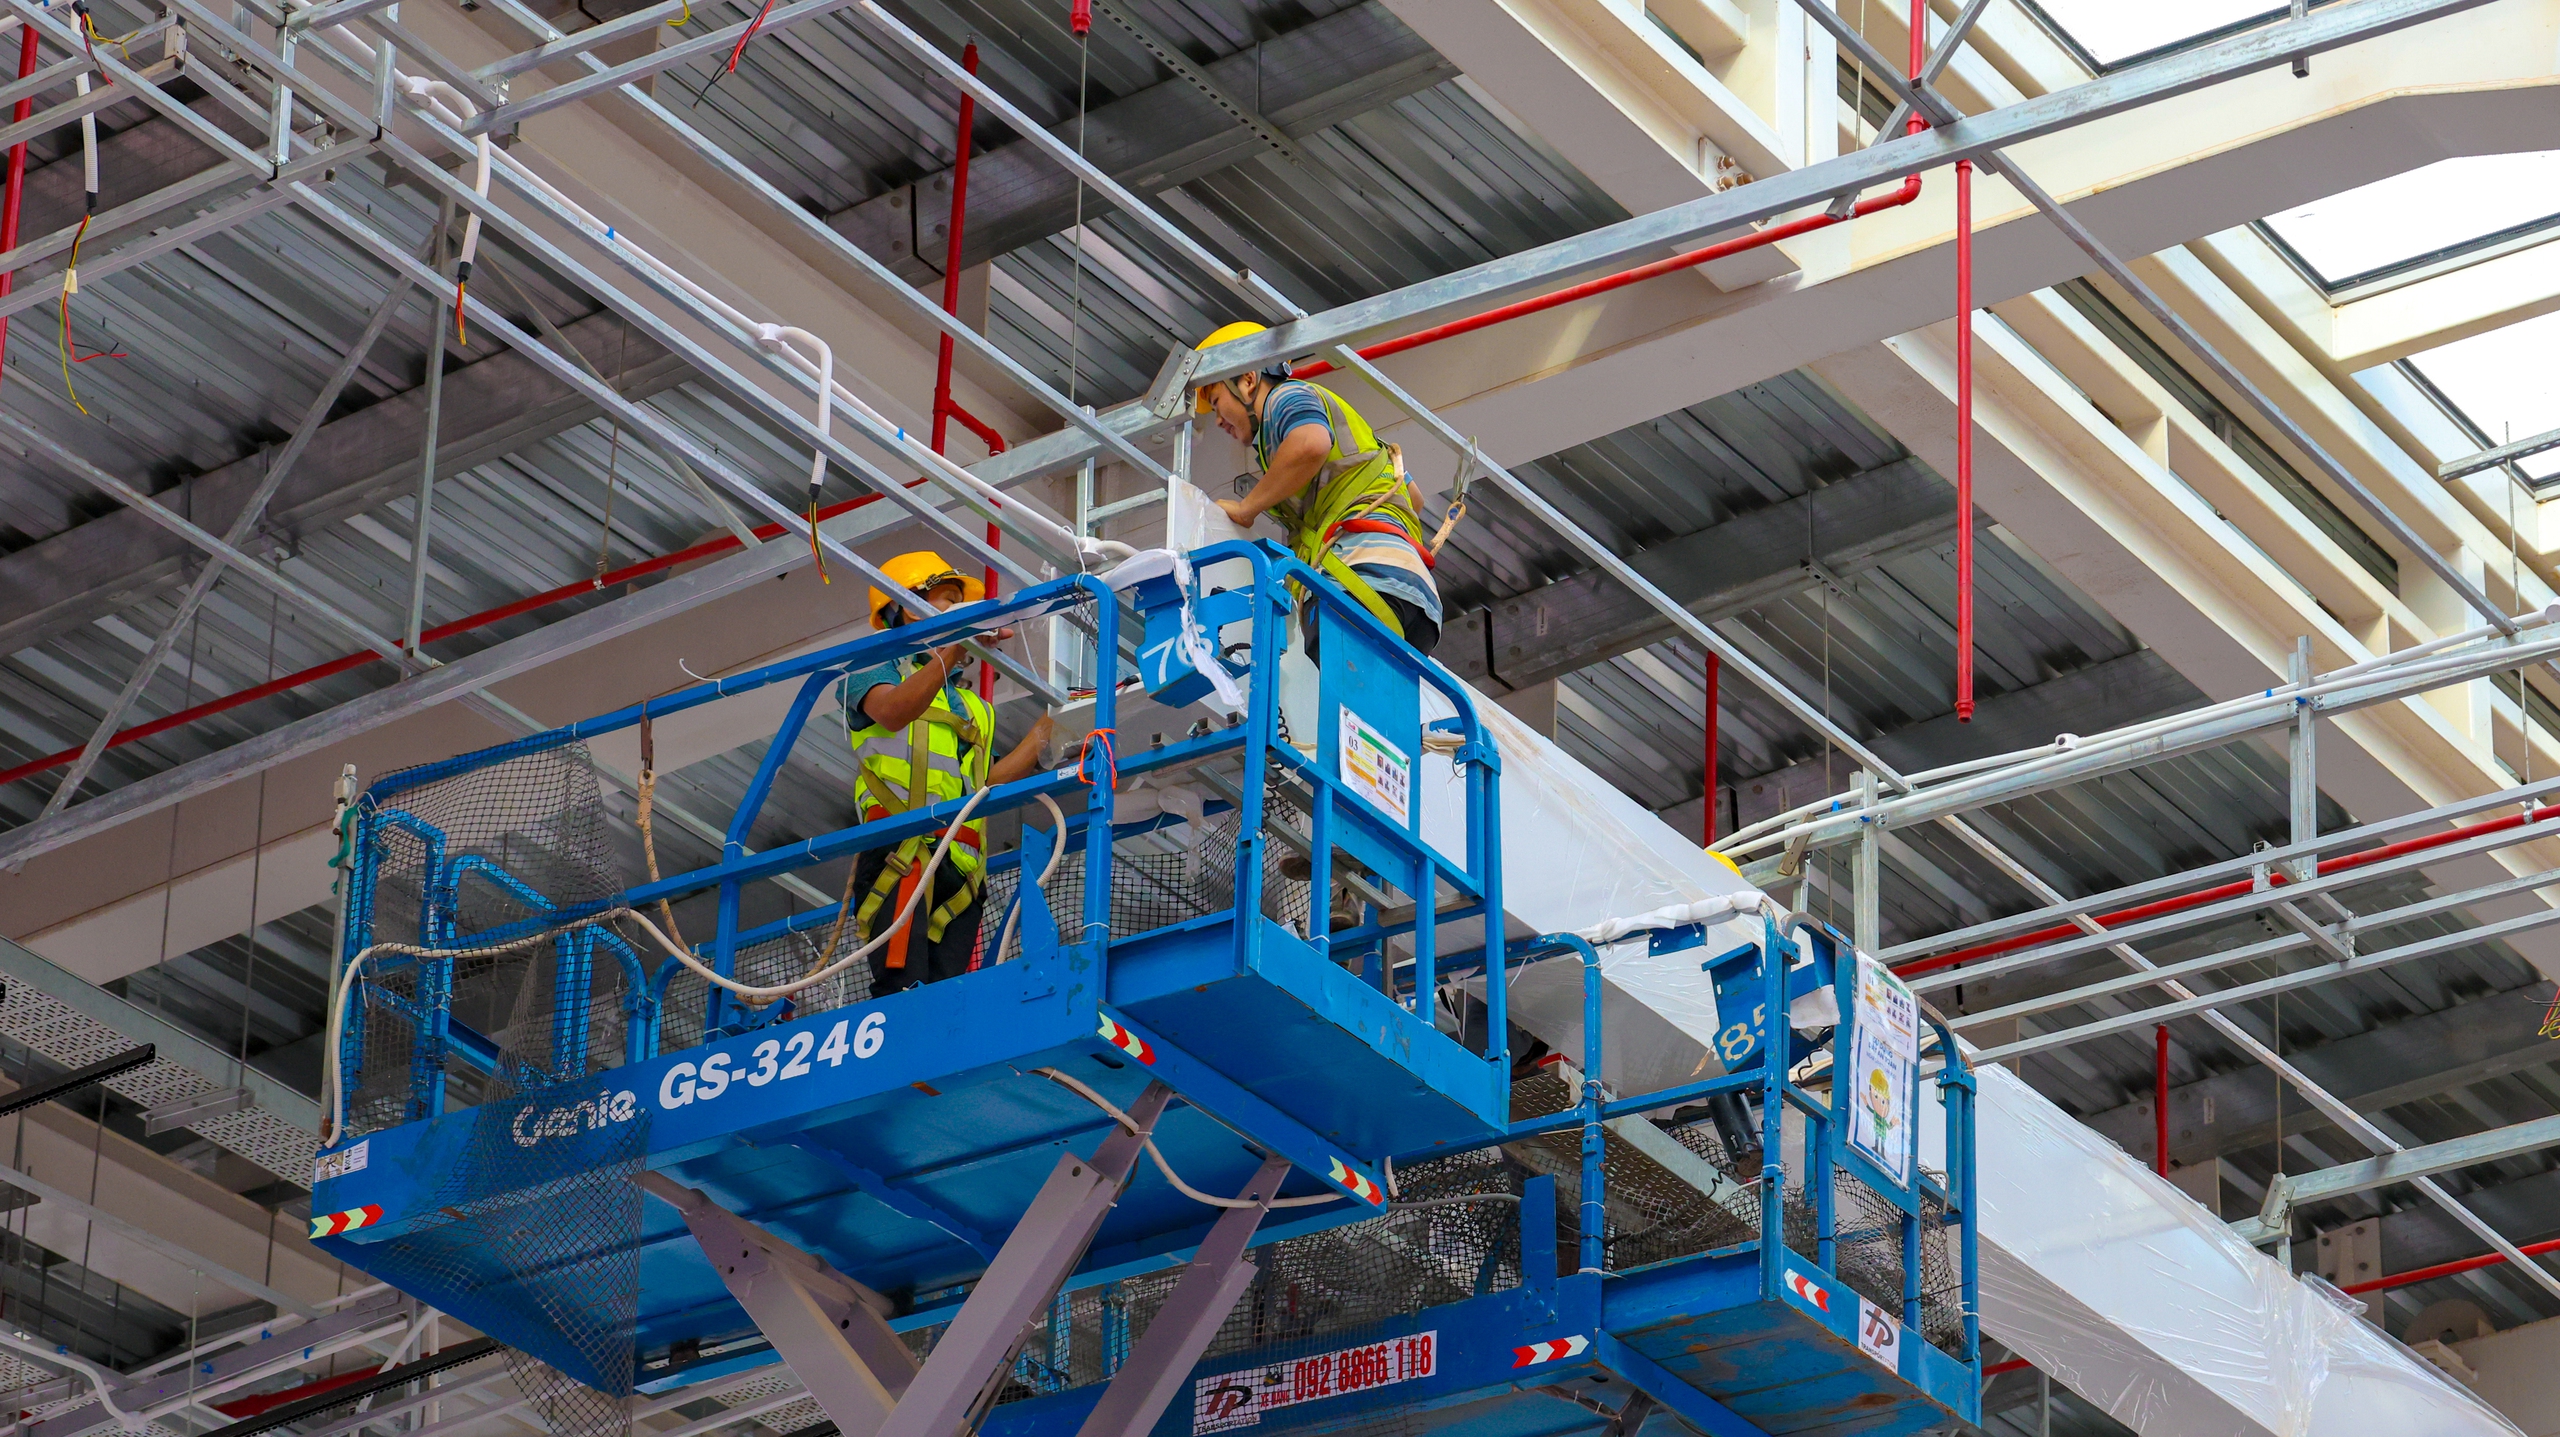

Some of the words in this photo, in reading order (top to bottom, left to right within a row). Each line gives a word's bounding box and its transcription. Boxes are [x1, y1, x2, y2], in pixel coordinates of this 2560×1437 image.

[1348, 735, 1359, 751] 03
[513, 1086, 637, 1147] Genie
[659, 1012, 886, 1110] GS-3246
[1295, 1356, 1332, 1401] 092
[1338, 1345, 1388, 1392] 8866
[1395, 1335, 1432, 1380] 118
